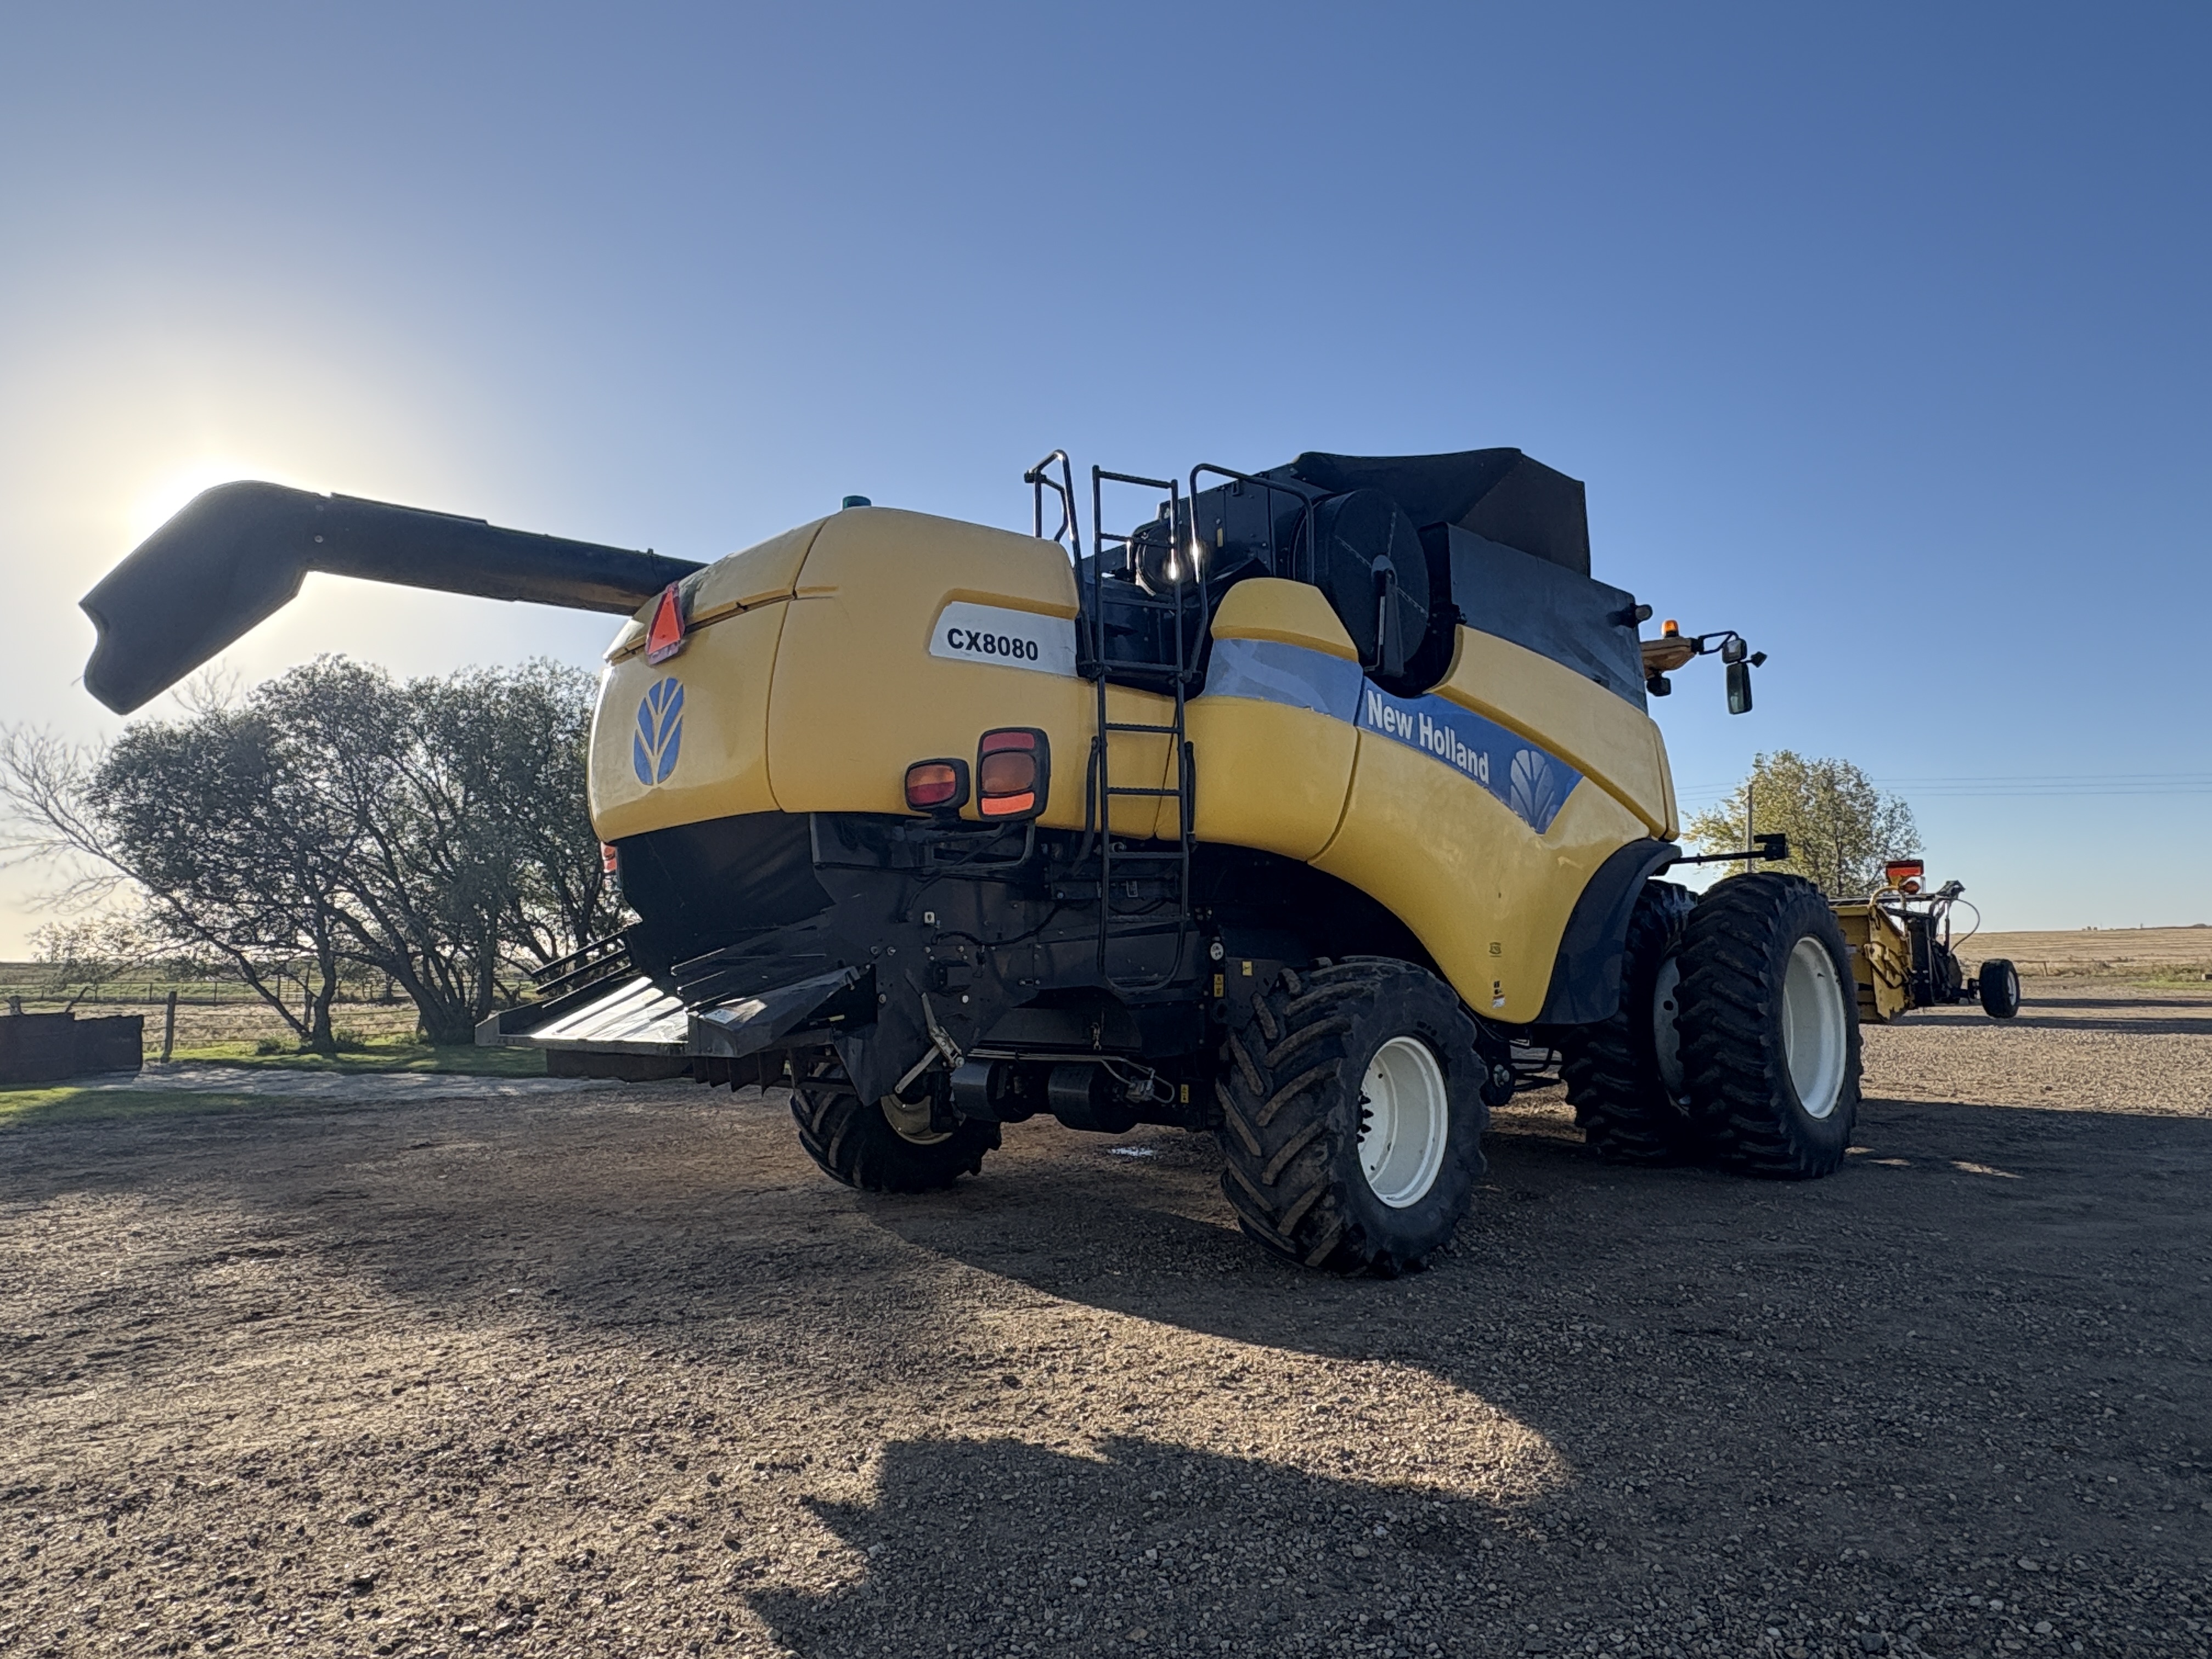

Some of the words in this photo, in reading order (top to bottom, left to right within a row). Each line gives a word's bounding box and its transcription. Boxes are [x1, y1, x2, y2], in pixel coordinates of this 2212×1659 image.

[947, 628, 1038, 661] CX8080
[1368, 690, 1413, 740] New
[1419, 713, 1489, 784] Holland
